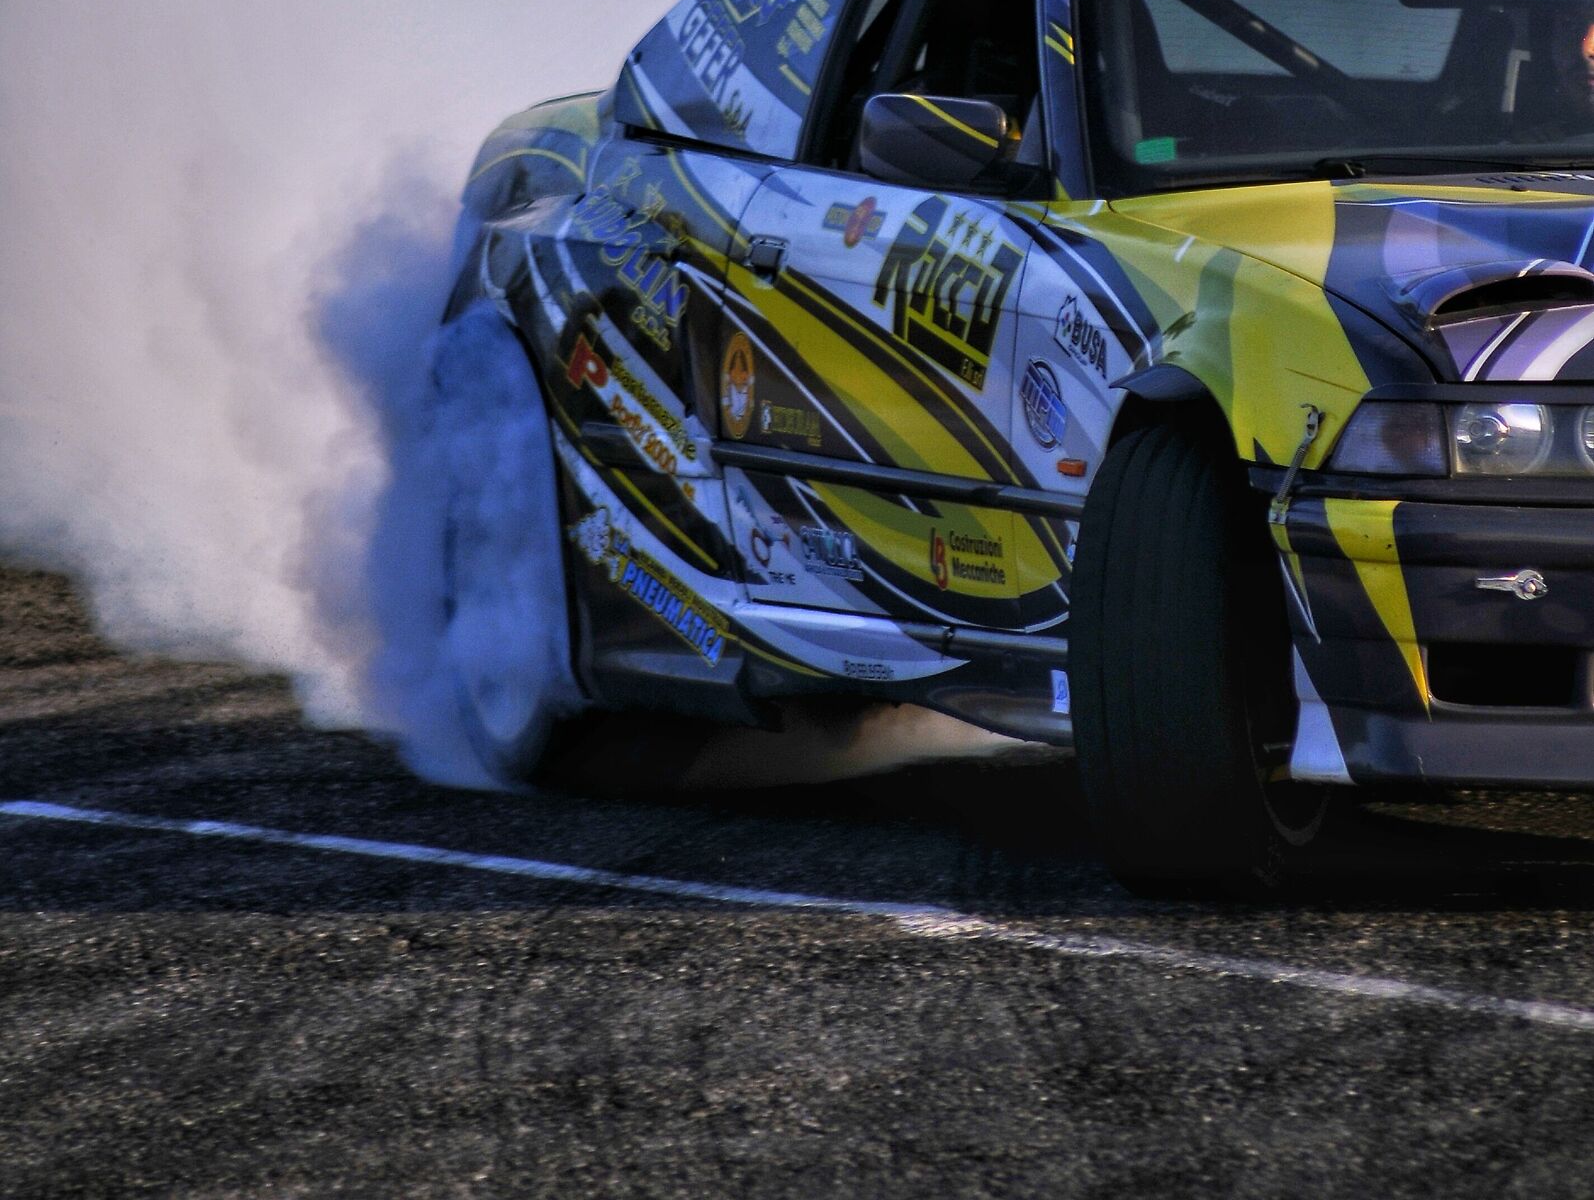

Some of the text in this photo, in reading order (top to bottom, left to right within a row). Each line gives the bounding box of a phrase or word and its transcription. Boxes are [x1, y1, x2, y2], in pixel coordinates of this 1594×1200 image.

[1071, 311, 1107, 379] BUSA
[950, 530, 1003, 558] Costruzioni
[952, 556, 1006, 585] Meccaniche
[620, 560, 726, 666] PNEUMATICA
